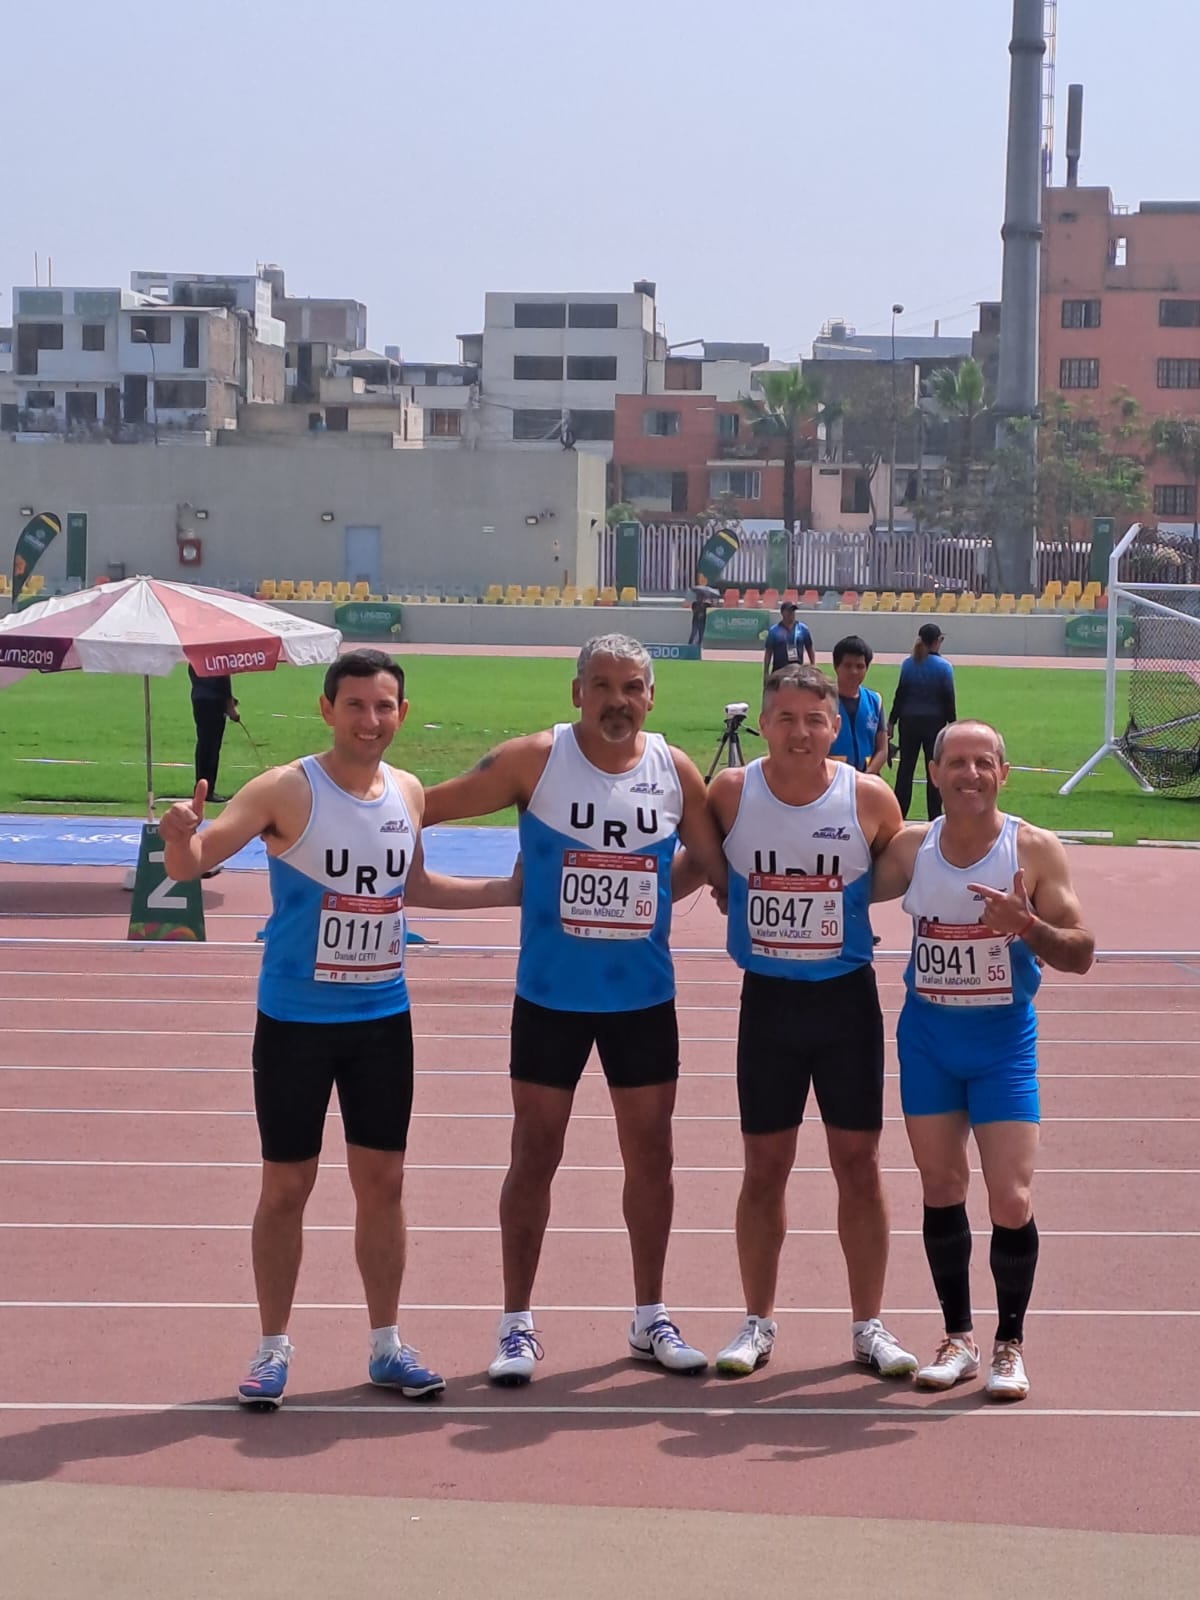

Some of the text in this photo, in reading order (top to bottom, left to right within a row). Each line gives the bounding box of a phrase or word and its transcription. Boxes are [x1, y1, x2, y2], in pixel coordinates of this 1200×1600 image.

[563, 873, 630, 907] 0934
[635, 900, 652, 917] 50
[749, 896, 814, 929] 0647
[323, 916, 383, 950] 0111
[821, 919, 838, 937] 50
[388, 939, 400, 956] 40
[917, 943, 975, 975] 0941
[988, 964, 1005, 981] 55
